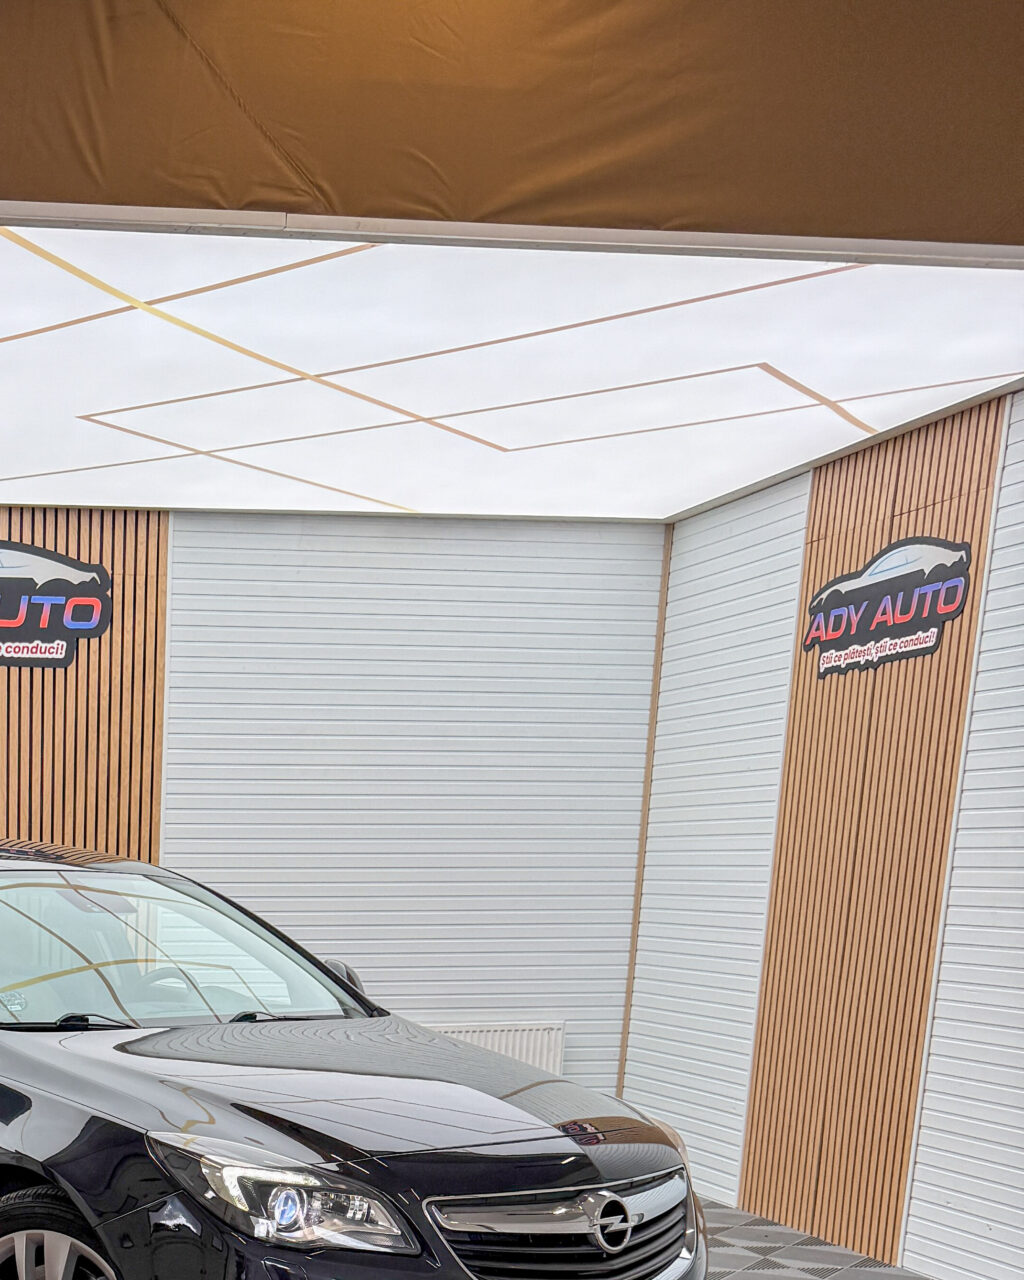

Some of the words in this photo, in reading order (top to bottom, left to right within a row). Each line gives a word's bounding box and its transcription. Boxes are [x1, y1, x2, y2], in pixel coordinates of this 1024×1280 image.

[805, 601, 869, 646] ADY
[870, 576, 965, 631] AUTO
[5, 642, 65, 655] conduci!
[833, 653, 842, 664] ce
[888, 641, 898, 652] ce
[898, 631, 936, 649] conduci!
